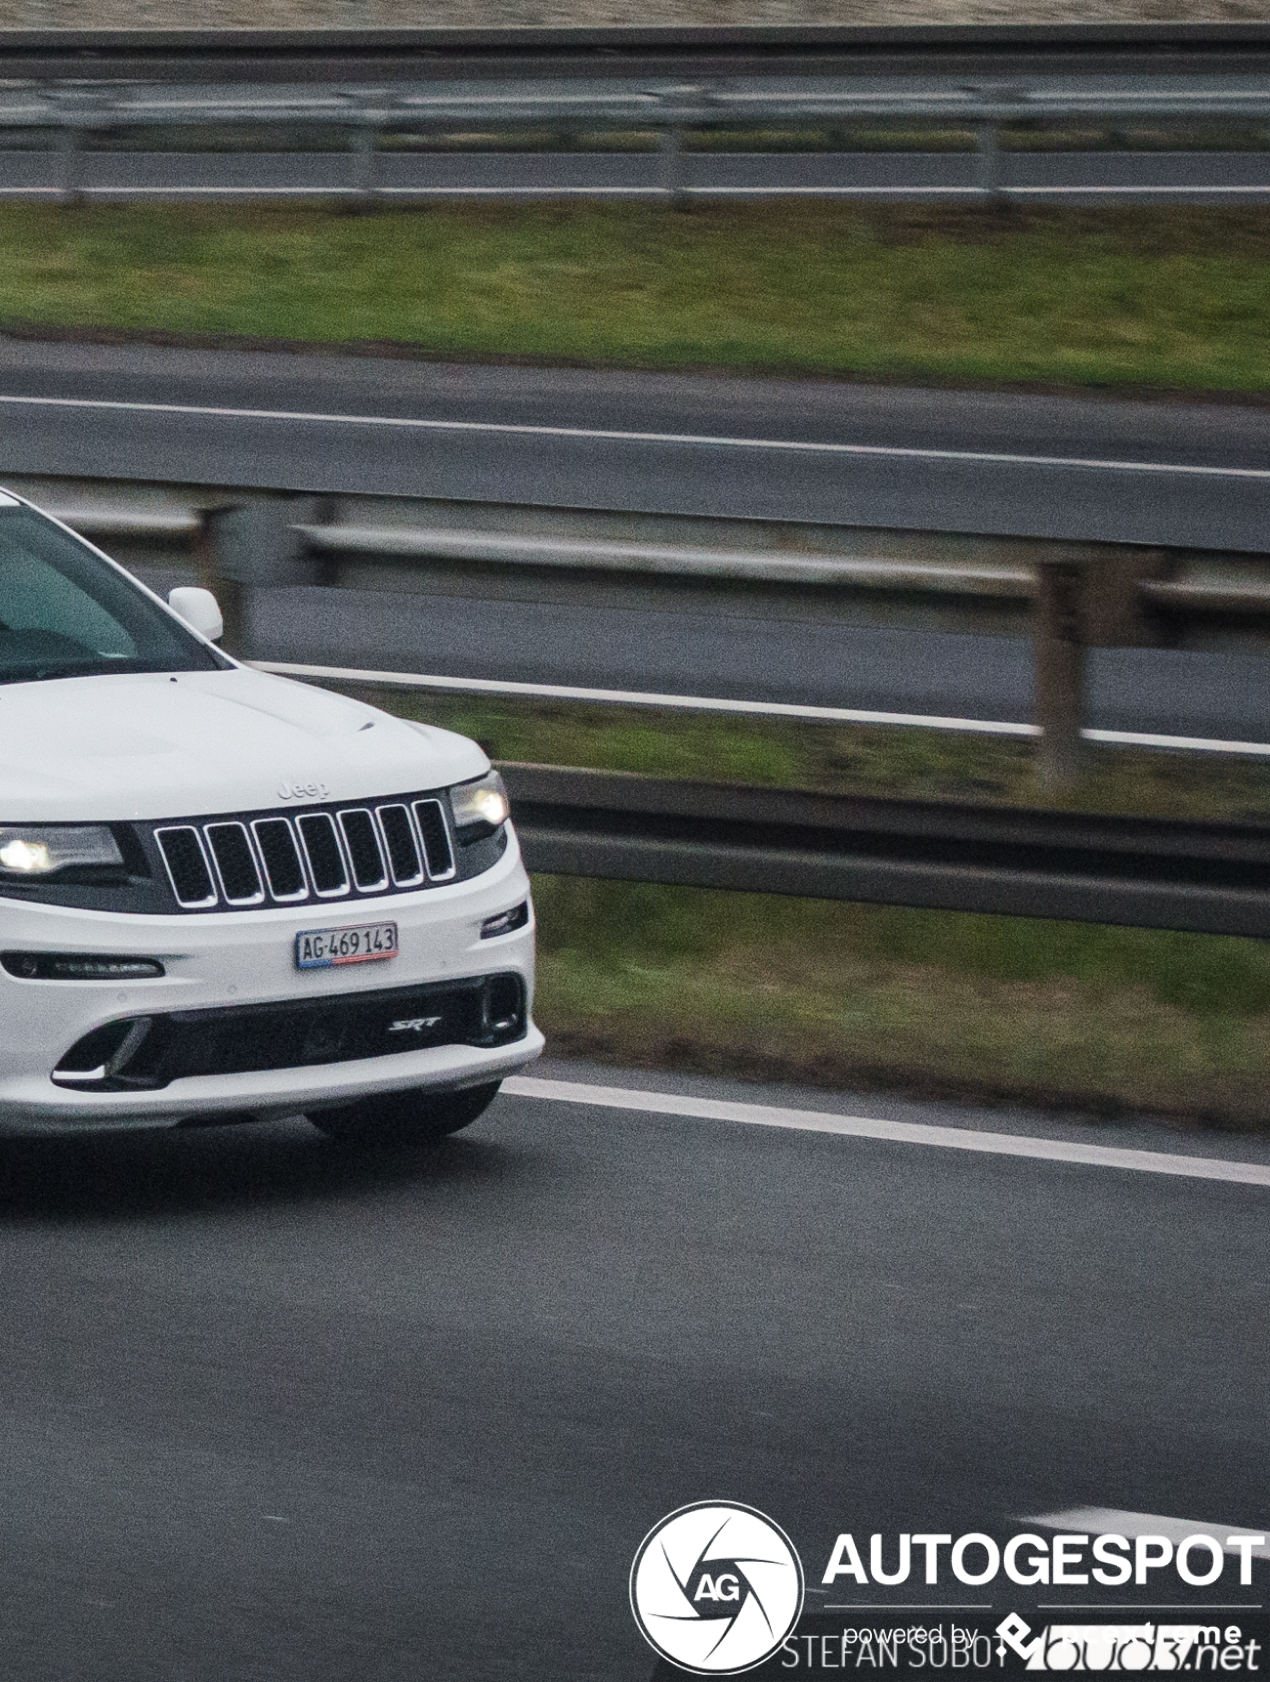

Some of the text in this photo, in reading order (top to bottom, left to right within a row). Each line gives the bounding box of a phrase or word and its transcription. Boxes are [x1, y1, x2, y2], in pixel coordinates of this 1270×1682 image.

[277, 780, 330, 800] Jeep
[364, 928, 394, 953] 143
[388, 1016, 443, 1031] SRT
